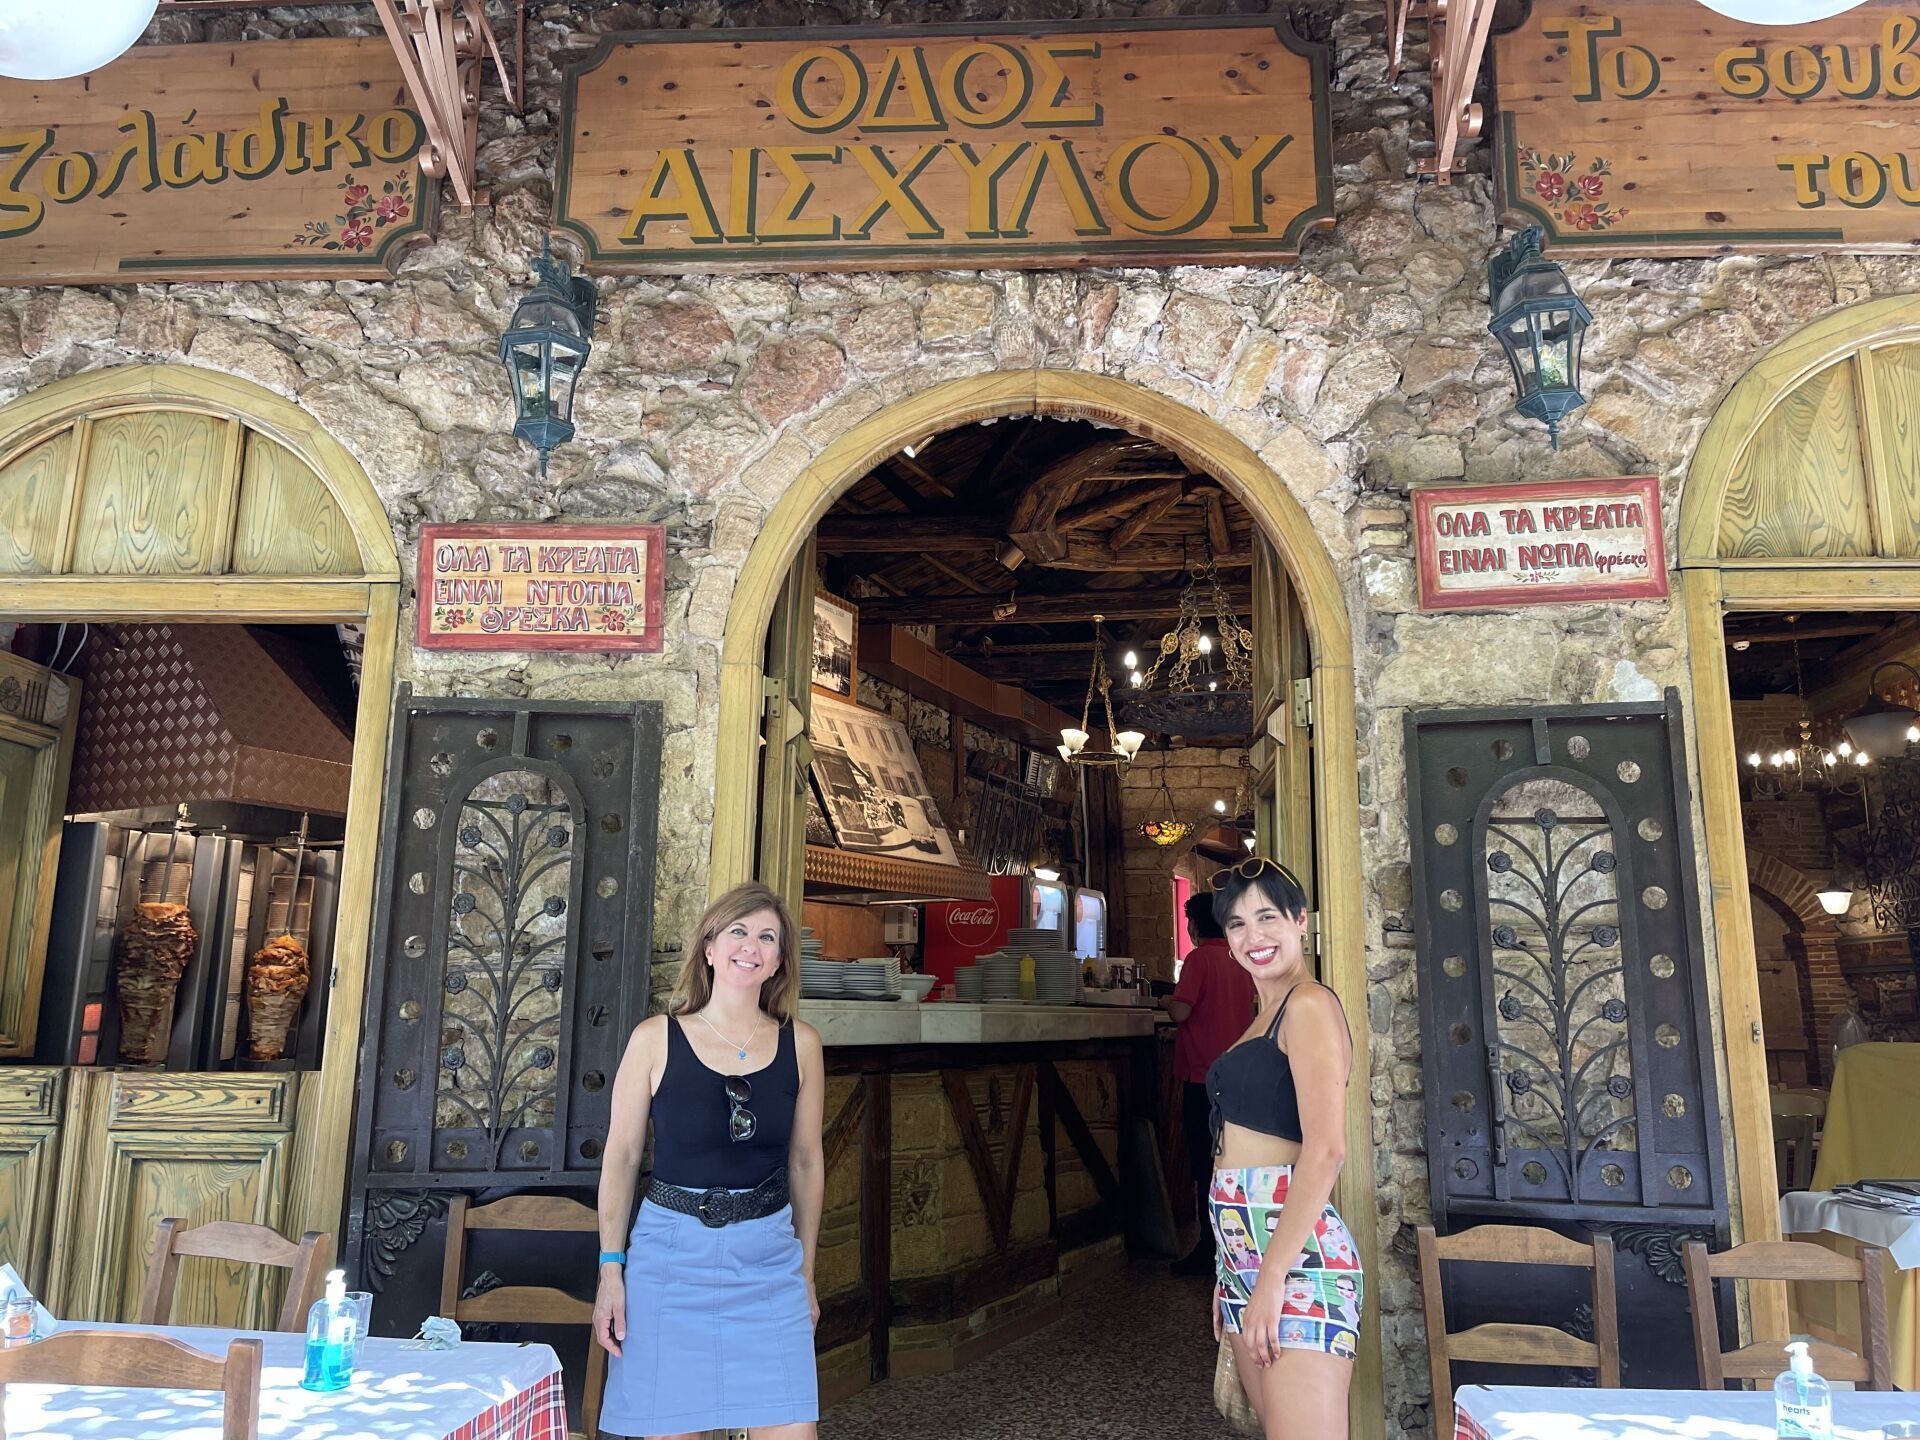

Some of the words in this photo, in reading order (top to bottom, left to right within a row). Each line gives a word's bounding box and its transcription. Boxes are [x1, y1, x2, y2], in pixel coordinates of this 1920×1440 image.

[1541, 15, 1661, 103] Το
[776, 43, 1103, 133] ΟΔΟΣ
[617, 135, 1293, 244] ΑΙΣΧΥΛΟΥ
[1437, 512, 1491, 537] ΟΛΑ
[1500, 507, 1537, 534] ΤΑ
[1543, 503, 1643, 532] ΚΡΕΑΤΑ
[437, 545, 489, 572] ΟΛΑ
[499, 546, 531, 572] ΤΑ
[538, 546, 639, 573] ΚΡΕΑΤΑ
[1438, 547, 1508, 575] ΕΙΝΑΙ
[1518, 542, 1594, 570] ΝΩΠΑ
[434, 578, 503, 605] ΕΙΝΑΙ
[527, 579, 633, 606] ΝΤΟΠΙΑ
[949, 908, 995, 925] Coca-Cola
